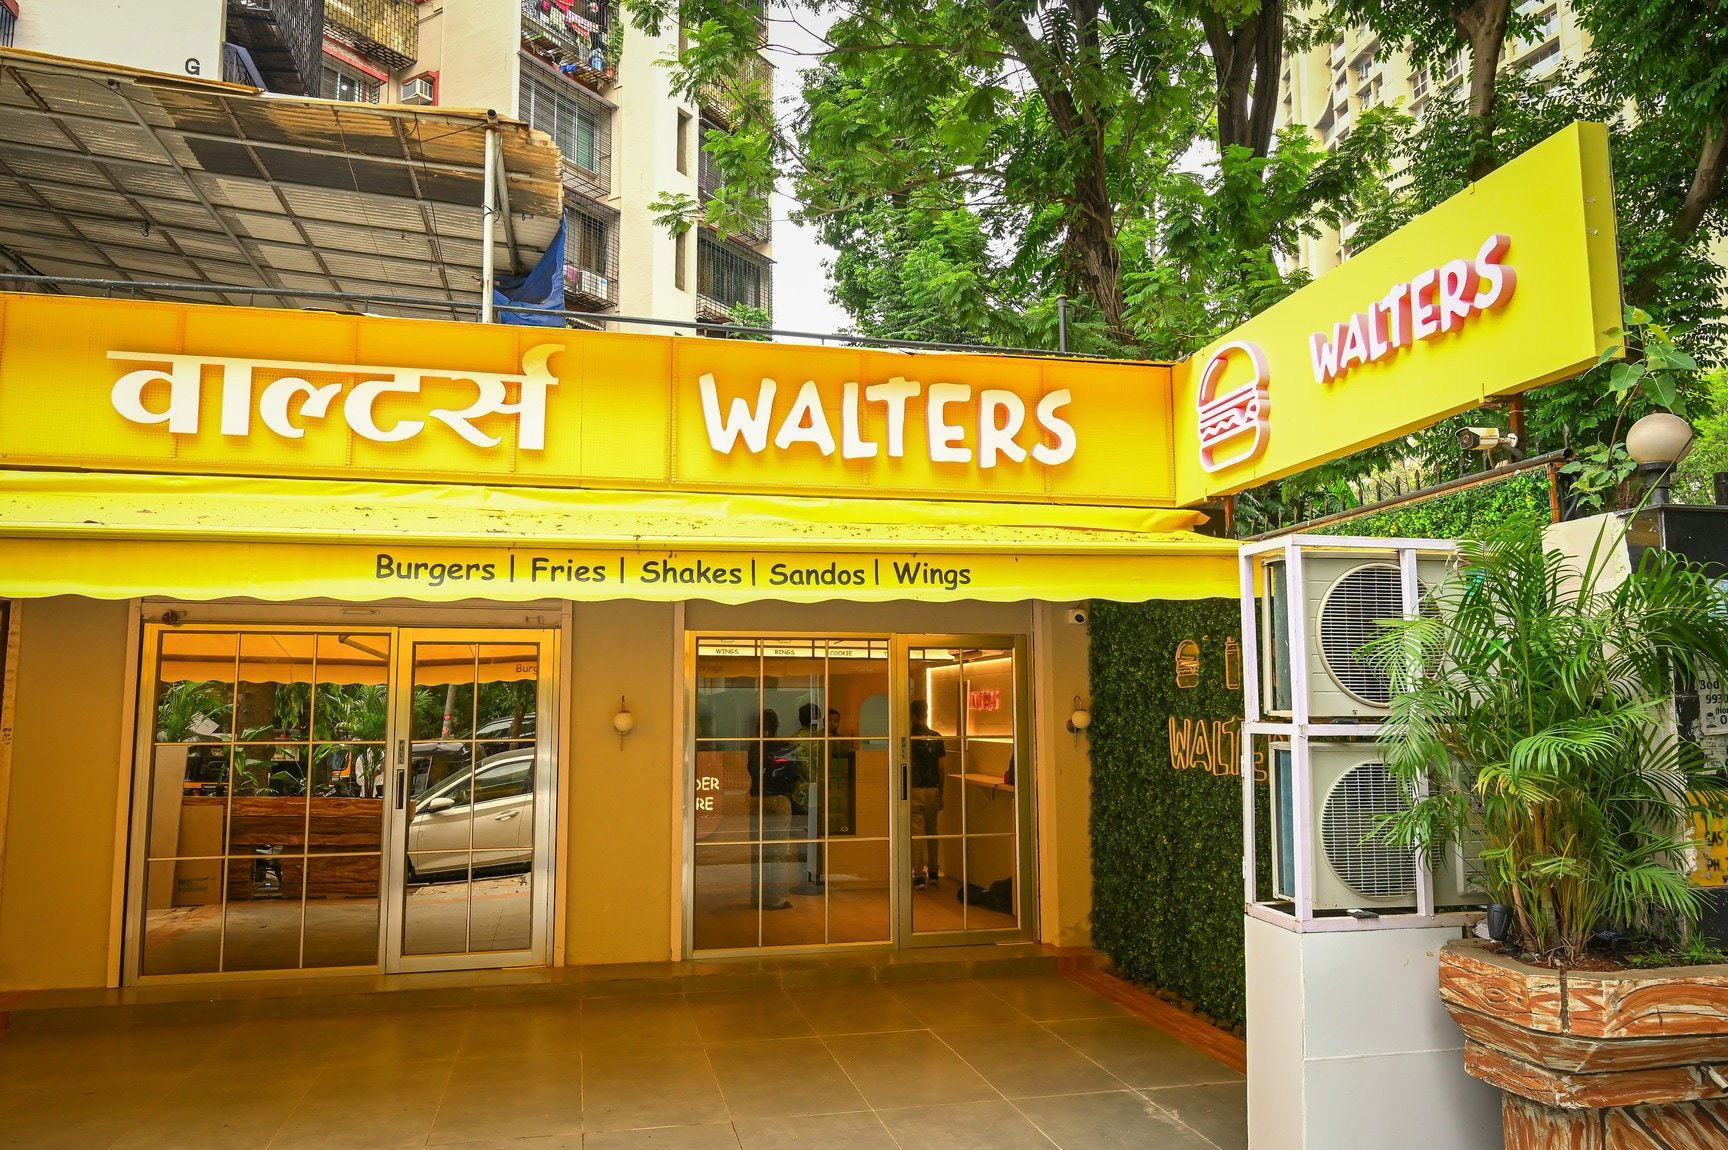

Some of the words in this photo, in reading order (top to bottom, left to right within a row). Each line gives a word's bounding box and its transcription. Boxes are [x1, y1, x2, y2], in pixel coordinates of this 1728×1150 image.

[184, 57, 200, 76] G
[1309, 234, 1516, 385] WALTERS
[106, 343, 566, 450] वाल्टर्स
[698, 372, 1077, 469] WALTERS
[375, 553, 496, 587] Burgers
[531, 557, 606, 583] Fries
[640, 559, 742, 585] Shakes
[769, 561, 865, 586] Sandos
[893, 561, 971, 591] Wings
